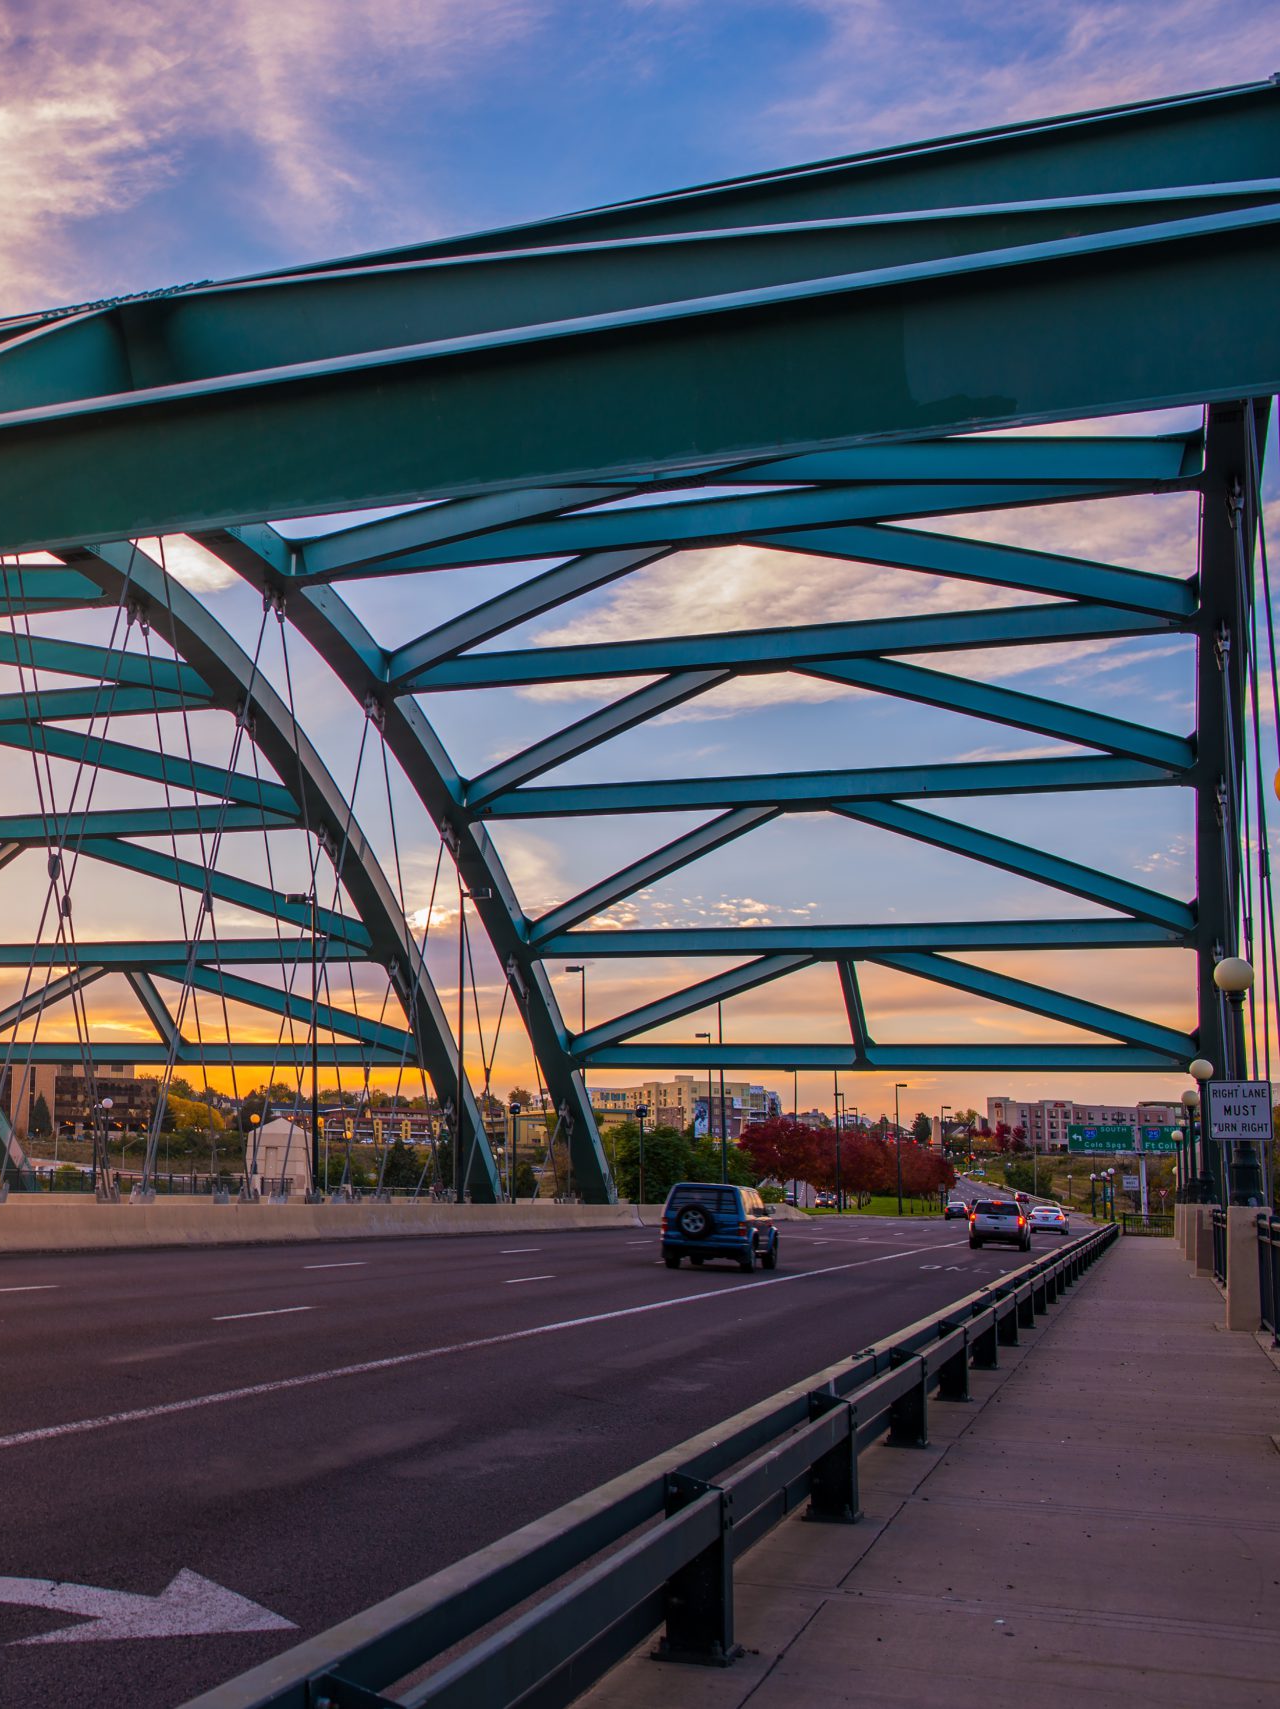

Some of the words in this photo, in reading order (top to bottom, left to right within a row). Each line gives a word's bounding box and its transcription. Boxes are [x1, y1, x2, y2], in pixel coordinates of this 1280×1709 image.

[1212, 1089, 1238, 1098] RIGHT
[1242, 1089, 1267, 1098] LANE
[1223, 1105, 1256, 1116] MUST
[1213, 1123, 1237, 1132] TURN
[1241, 1123, 1269, 1132] RIGHT
